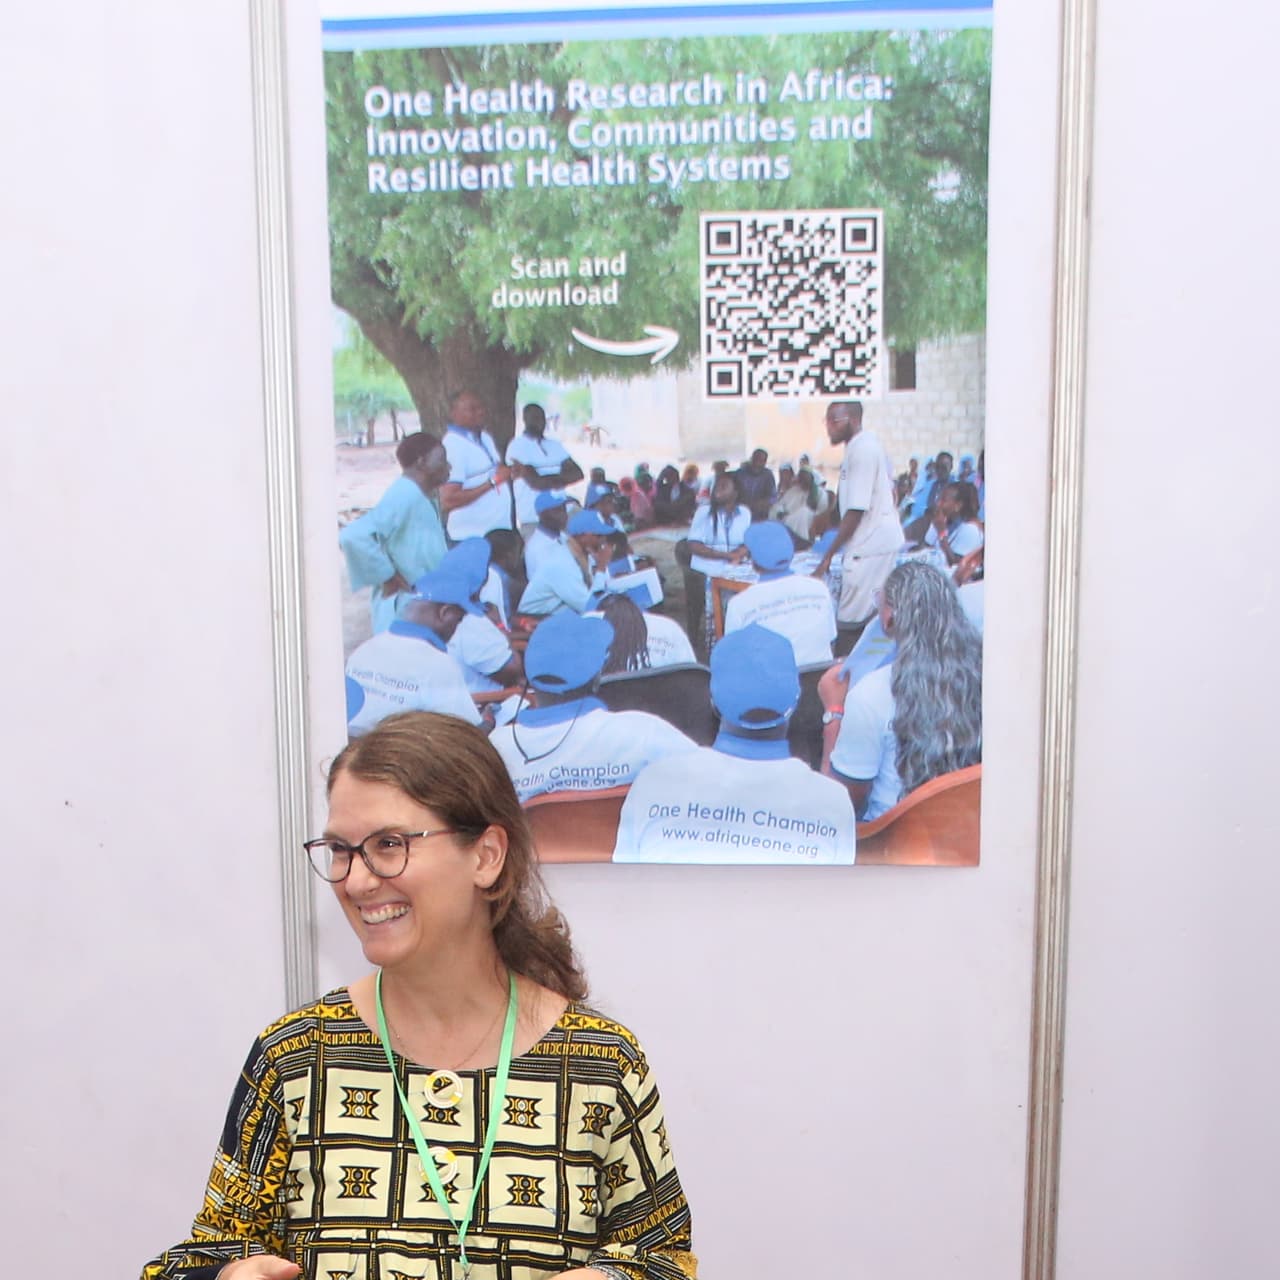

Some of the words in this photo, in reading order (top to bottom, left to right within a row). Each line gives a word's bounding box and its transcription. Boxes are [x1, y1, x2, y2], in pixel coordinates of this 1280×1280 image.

[364, 86, 434, 118] One
[443, 83, 555, 115] Health
[566, 78, 724, 111] Research
[736, 72, 768, 103] in
[779, 69, 894, 103] Africa:
[365, 121, 557, 156] Innovation,
[567, 111, 796, 149] Communities
[808, 107, 873, 141] and
[367, 158, 513, 193] Resilient
[525, 154, 637, 187] Health
[647, 149, 791, 191] Systems
[510, 255, 569, 281] Scan
[578, 251, 627, 278] and
[491, 281, 618, 309] download
[549, 763, 630, 780] Champion
[648, 804, 681, 819] One
[687, 802, 746, 825] Health
[752, 810, 838, 839] Champion
[662, 826, 818, 858] www.afriqueone.org
